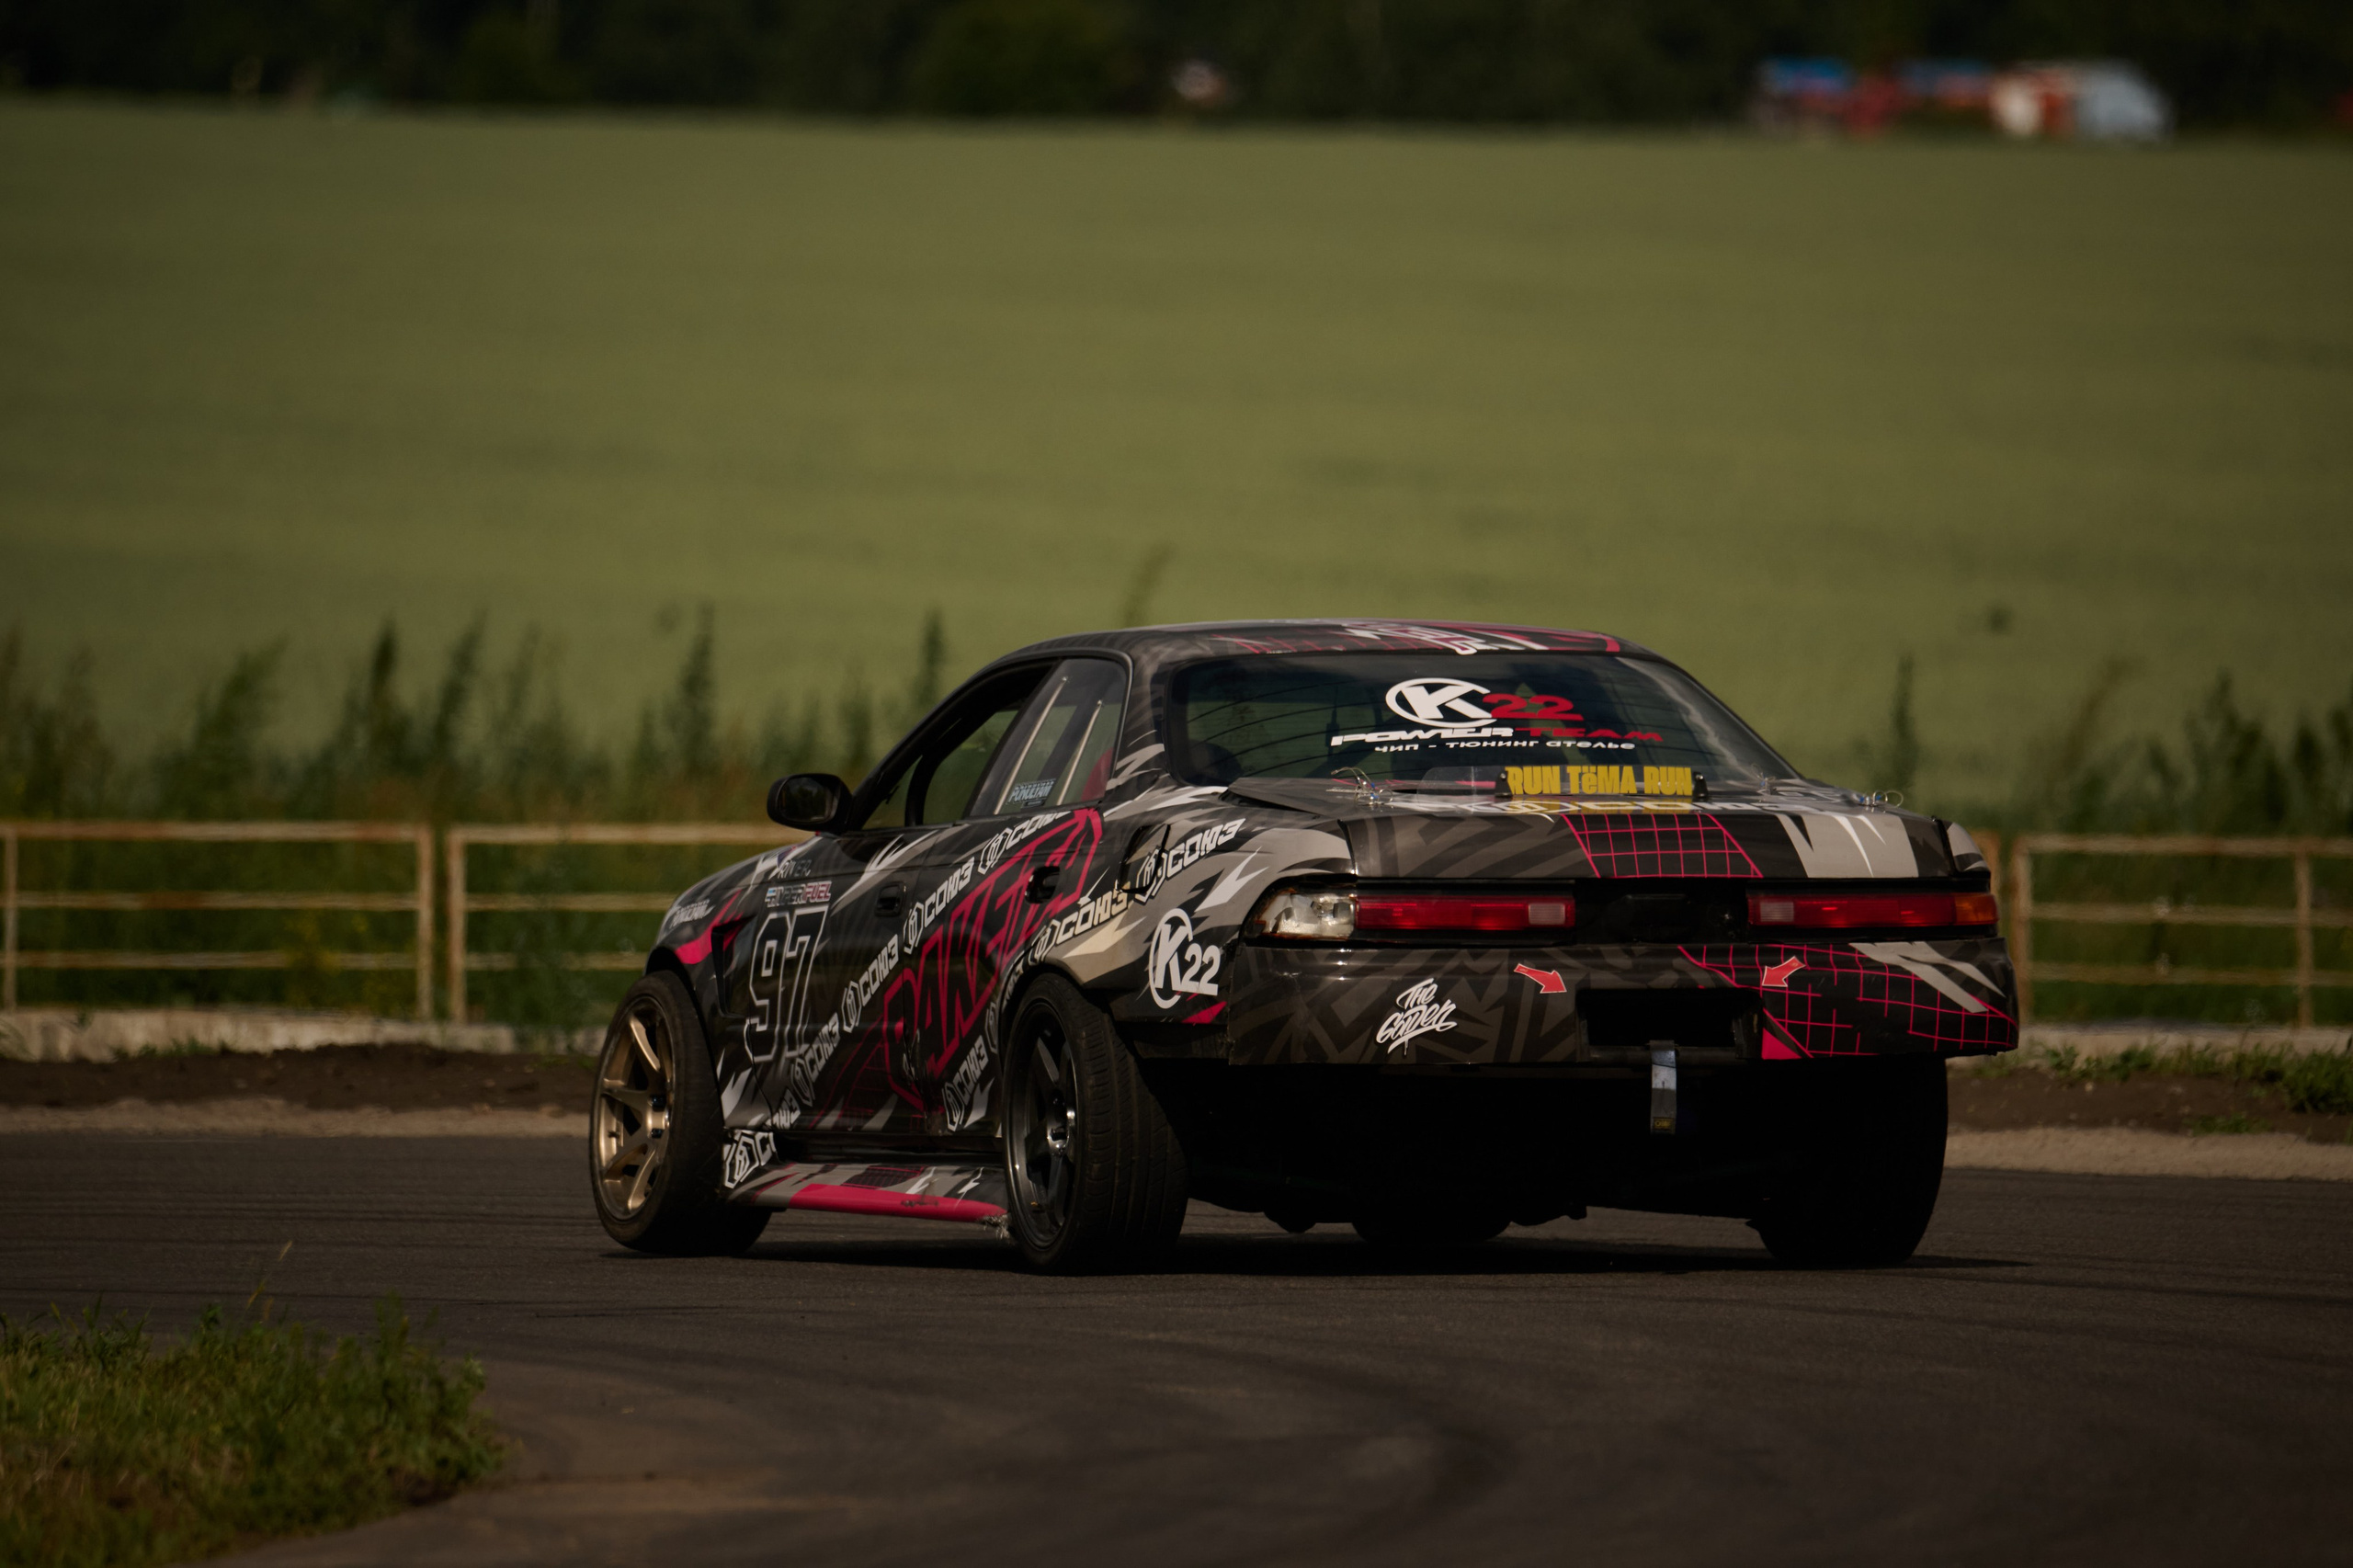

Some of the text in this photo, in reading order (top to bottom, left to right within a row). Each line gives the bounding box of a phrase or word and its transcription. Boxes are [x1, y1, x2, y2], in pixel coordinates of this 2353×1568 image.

[1387, 679, 1584, 726] K22
[1330, 727, 1664, 746] POWER TEAM
[1445, 740, 1539, 748] тюнинг
[1505, 766, 1561, 795] RUN
[1643, 766, 1693, 796] RUN
[1006, 811, 1072, 850] СОЮ
[1167, 818, 1246, 878] СОЮЗ
[925, 856, 975, 928] СОЮЗ
[1056, 882, 1129, 945] СОЮЗ
[744, 904, 830, 1063] 97
[858, 934, 900, 1007] СОЮЗ
[1150, 910, 1221, 1007] K22
[806, 1012, 841, 1083] СОЮЗ
[952, 1034, 989, 1106] СОЮЗ
